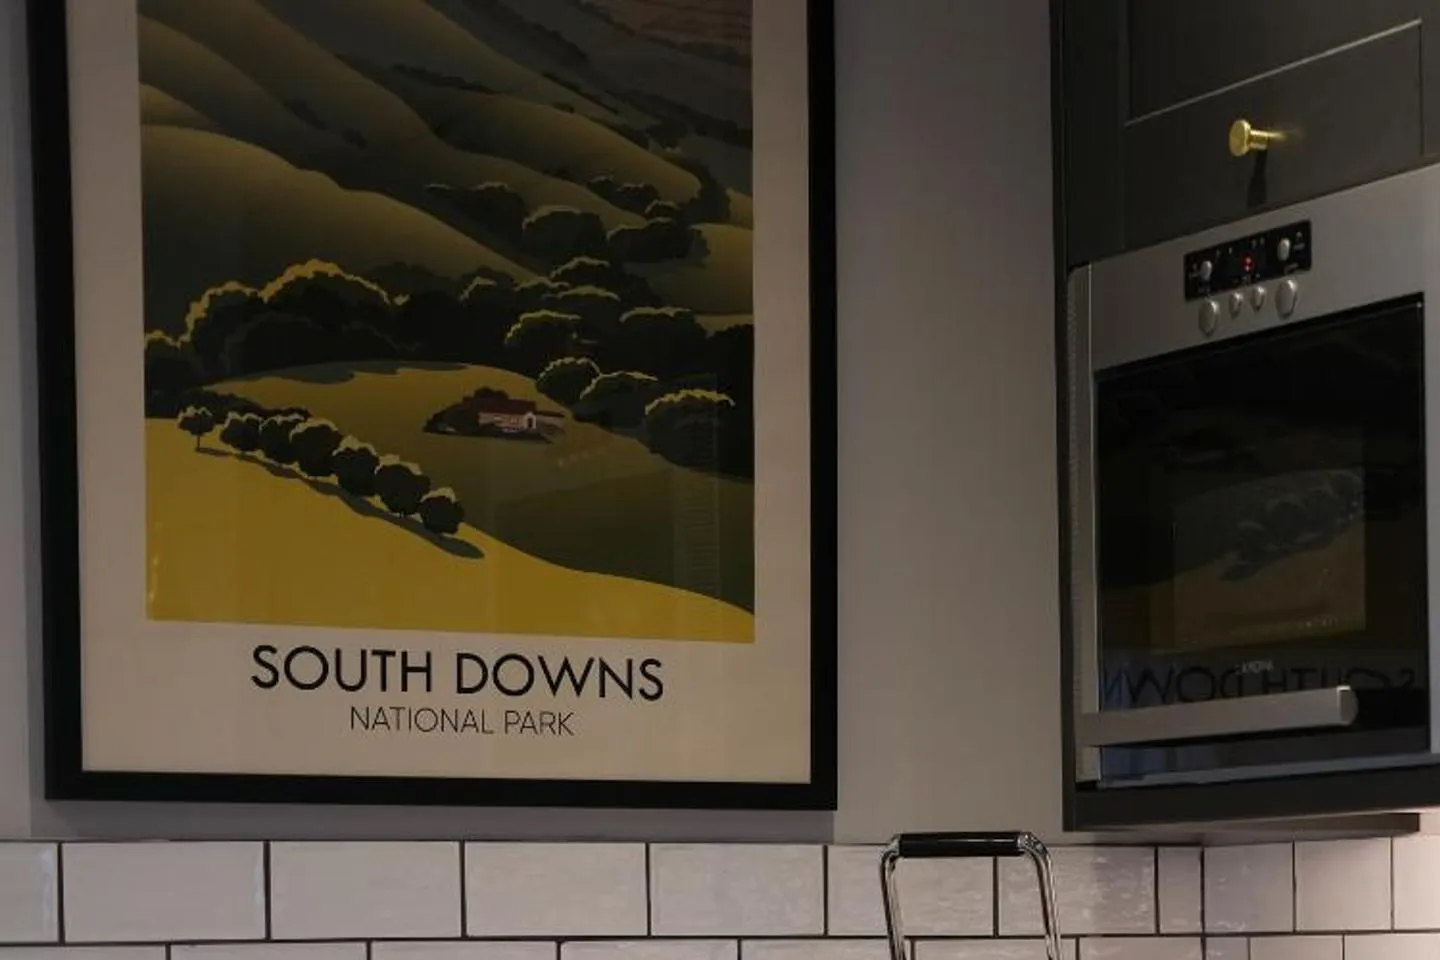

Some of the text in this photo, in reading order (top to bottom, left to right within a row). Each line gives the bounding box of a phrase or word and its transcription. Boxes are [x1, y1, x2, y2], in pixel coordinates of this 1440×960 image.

[251, 645, 664, 701] SOUTH DOWNS
[350, 705, 575, 737] NATIONAL PARK
